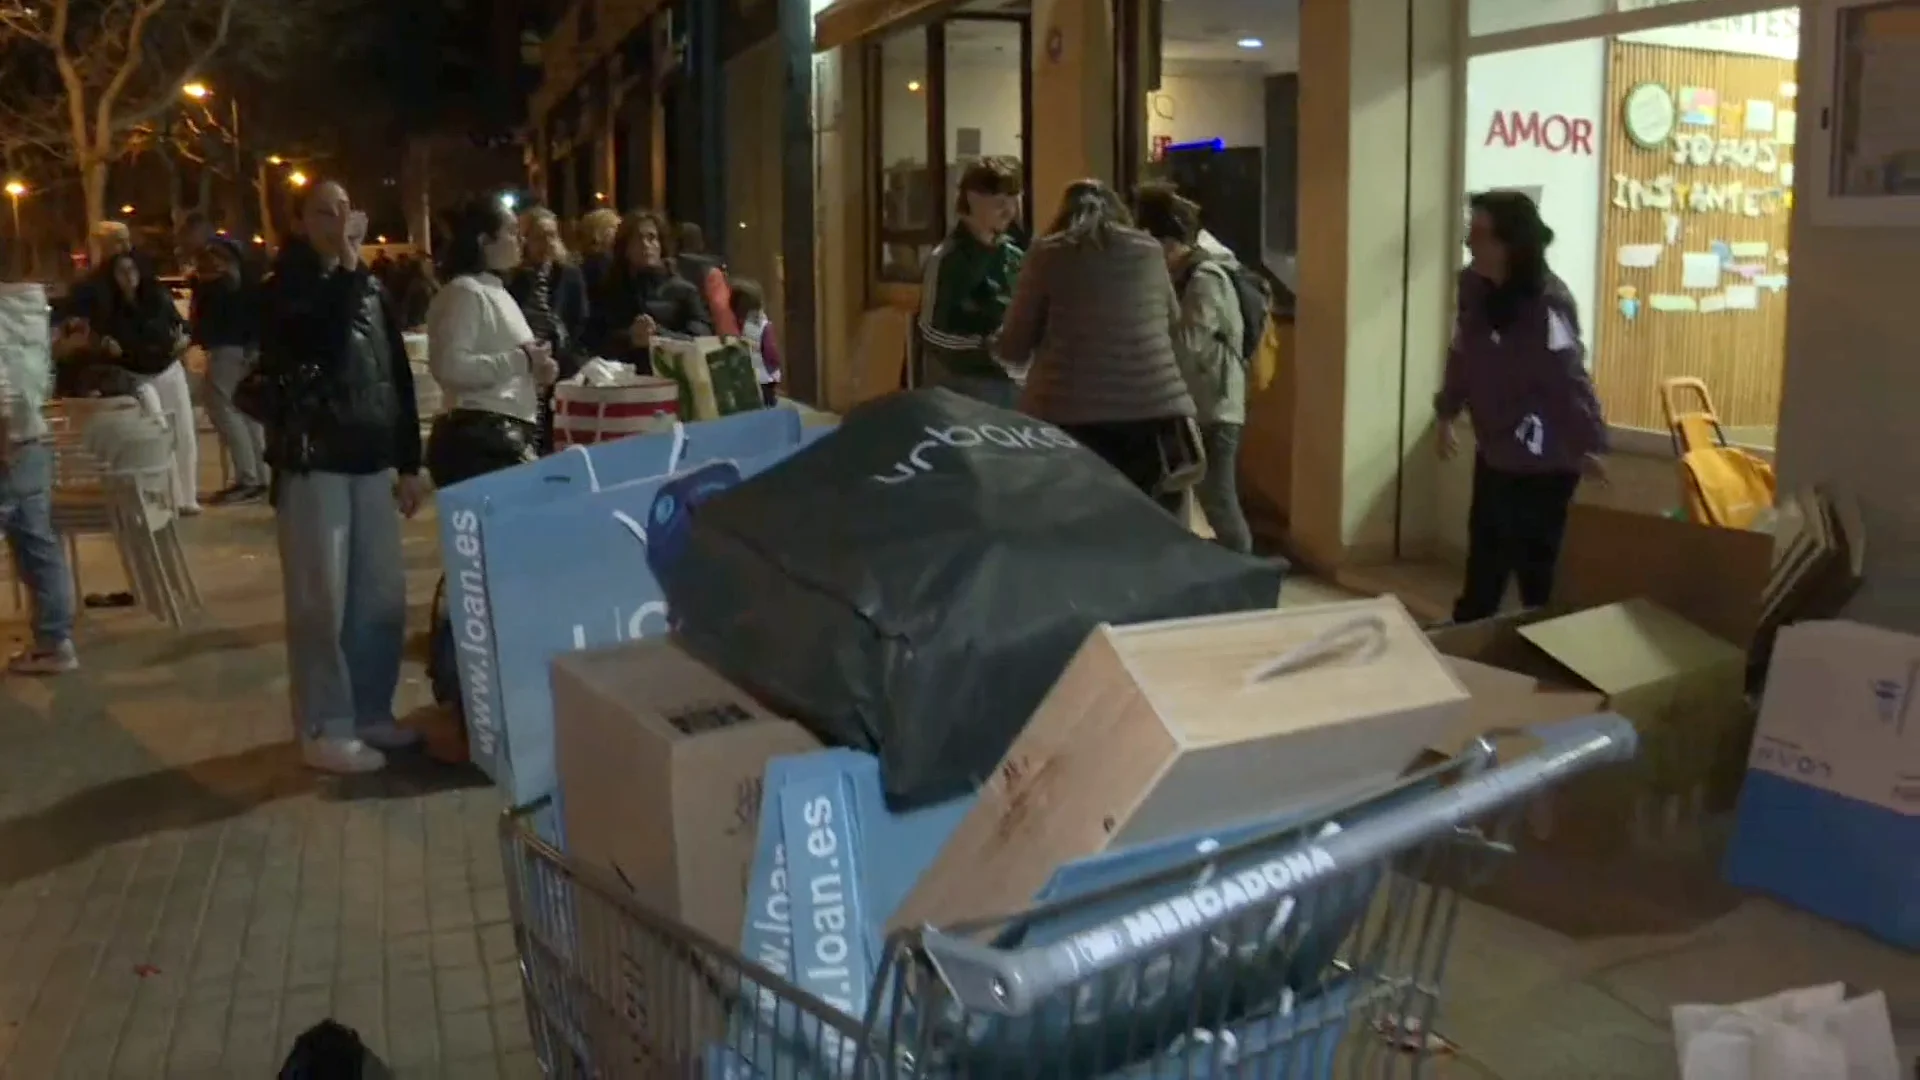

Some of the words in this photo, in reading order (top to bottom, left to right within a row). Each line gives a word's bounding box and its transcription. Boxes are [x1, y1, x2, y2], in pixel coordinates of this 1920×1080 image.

[1483, 109, 1592, 155] AMOR
[1673, 133, 1777, 173] SOMOS
[452, 508, 496, 756] www.loan.es
[1122, 847, 1336, 948] MERCADONA
